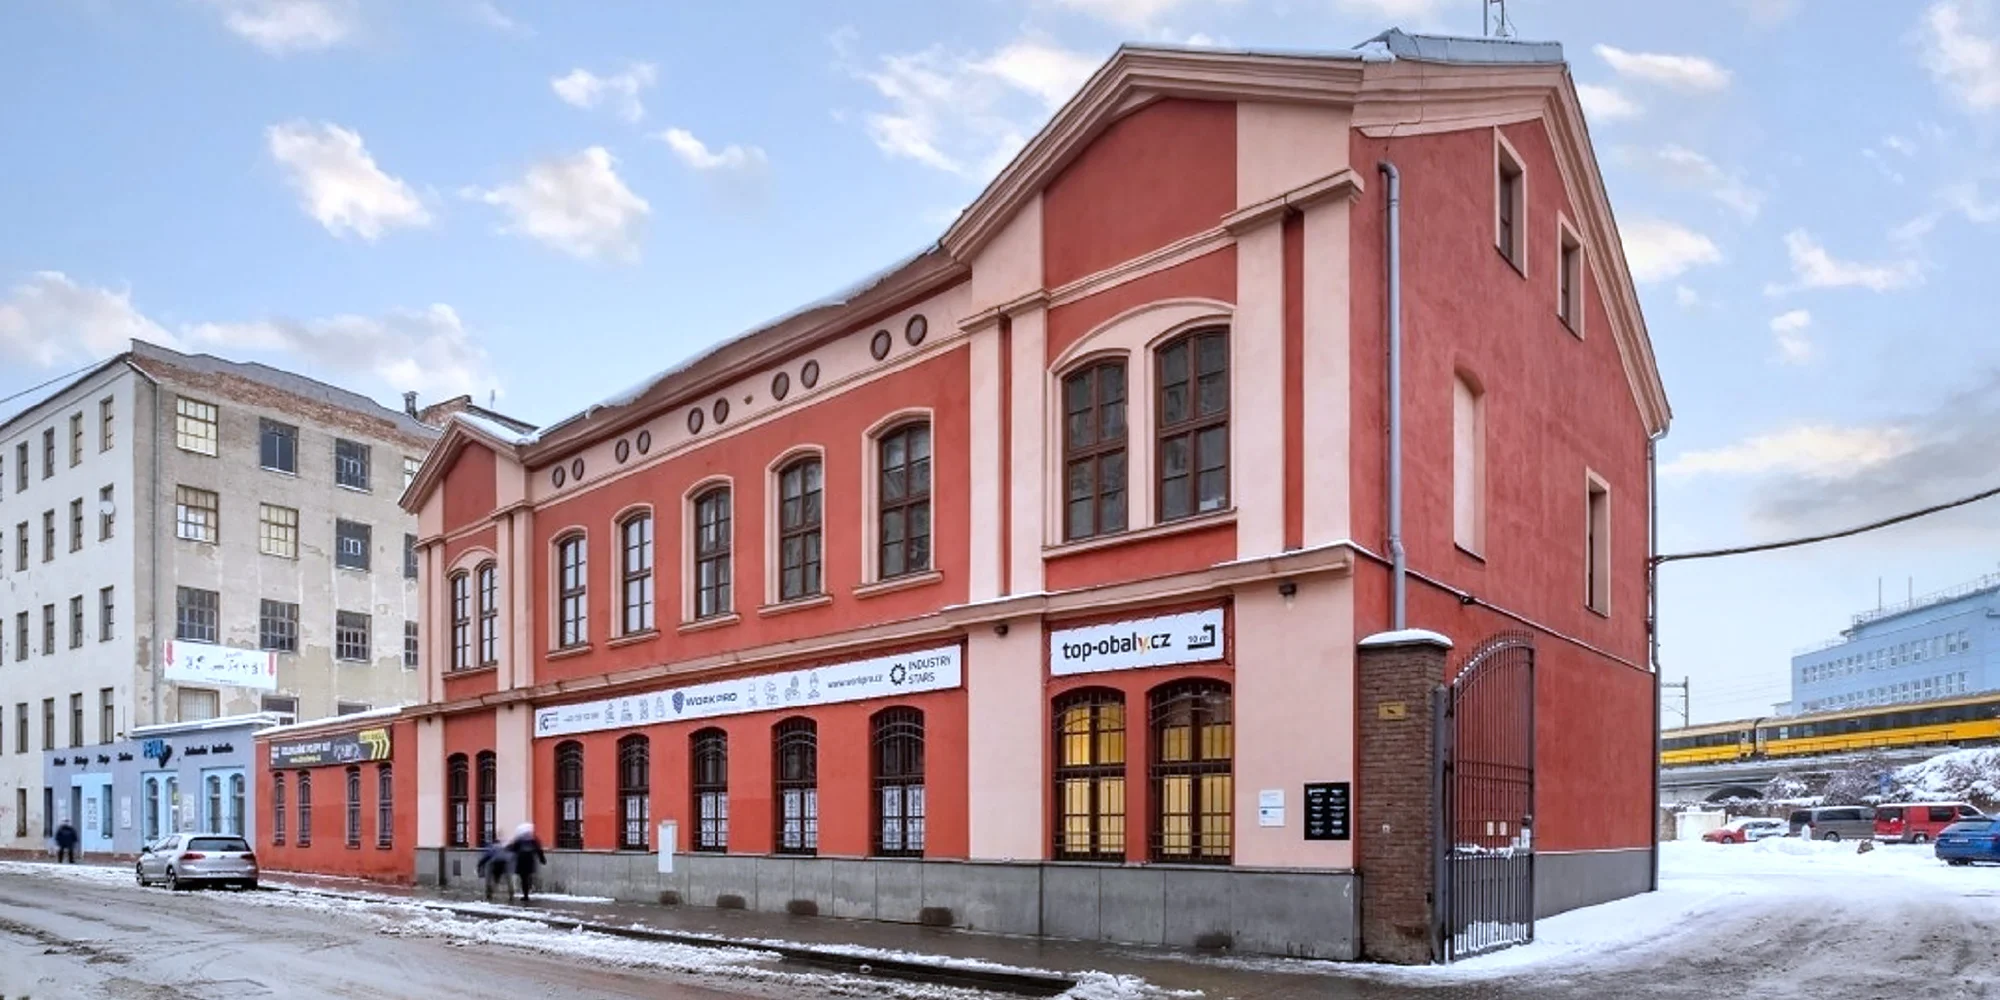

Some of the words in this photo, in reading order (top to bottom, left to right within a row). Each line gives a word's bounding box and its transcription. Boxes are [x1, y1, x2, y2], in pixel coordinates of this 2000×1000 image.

[1062, 632, 1171, 661] top-obaly.cz
[908, 655, 952, 671] INDUSTRY
[908, 672, 935, 685] STARS
